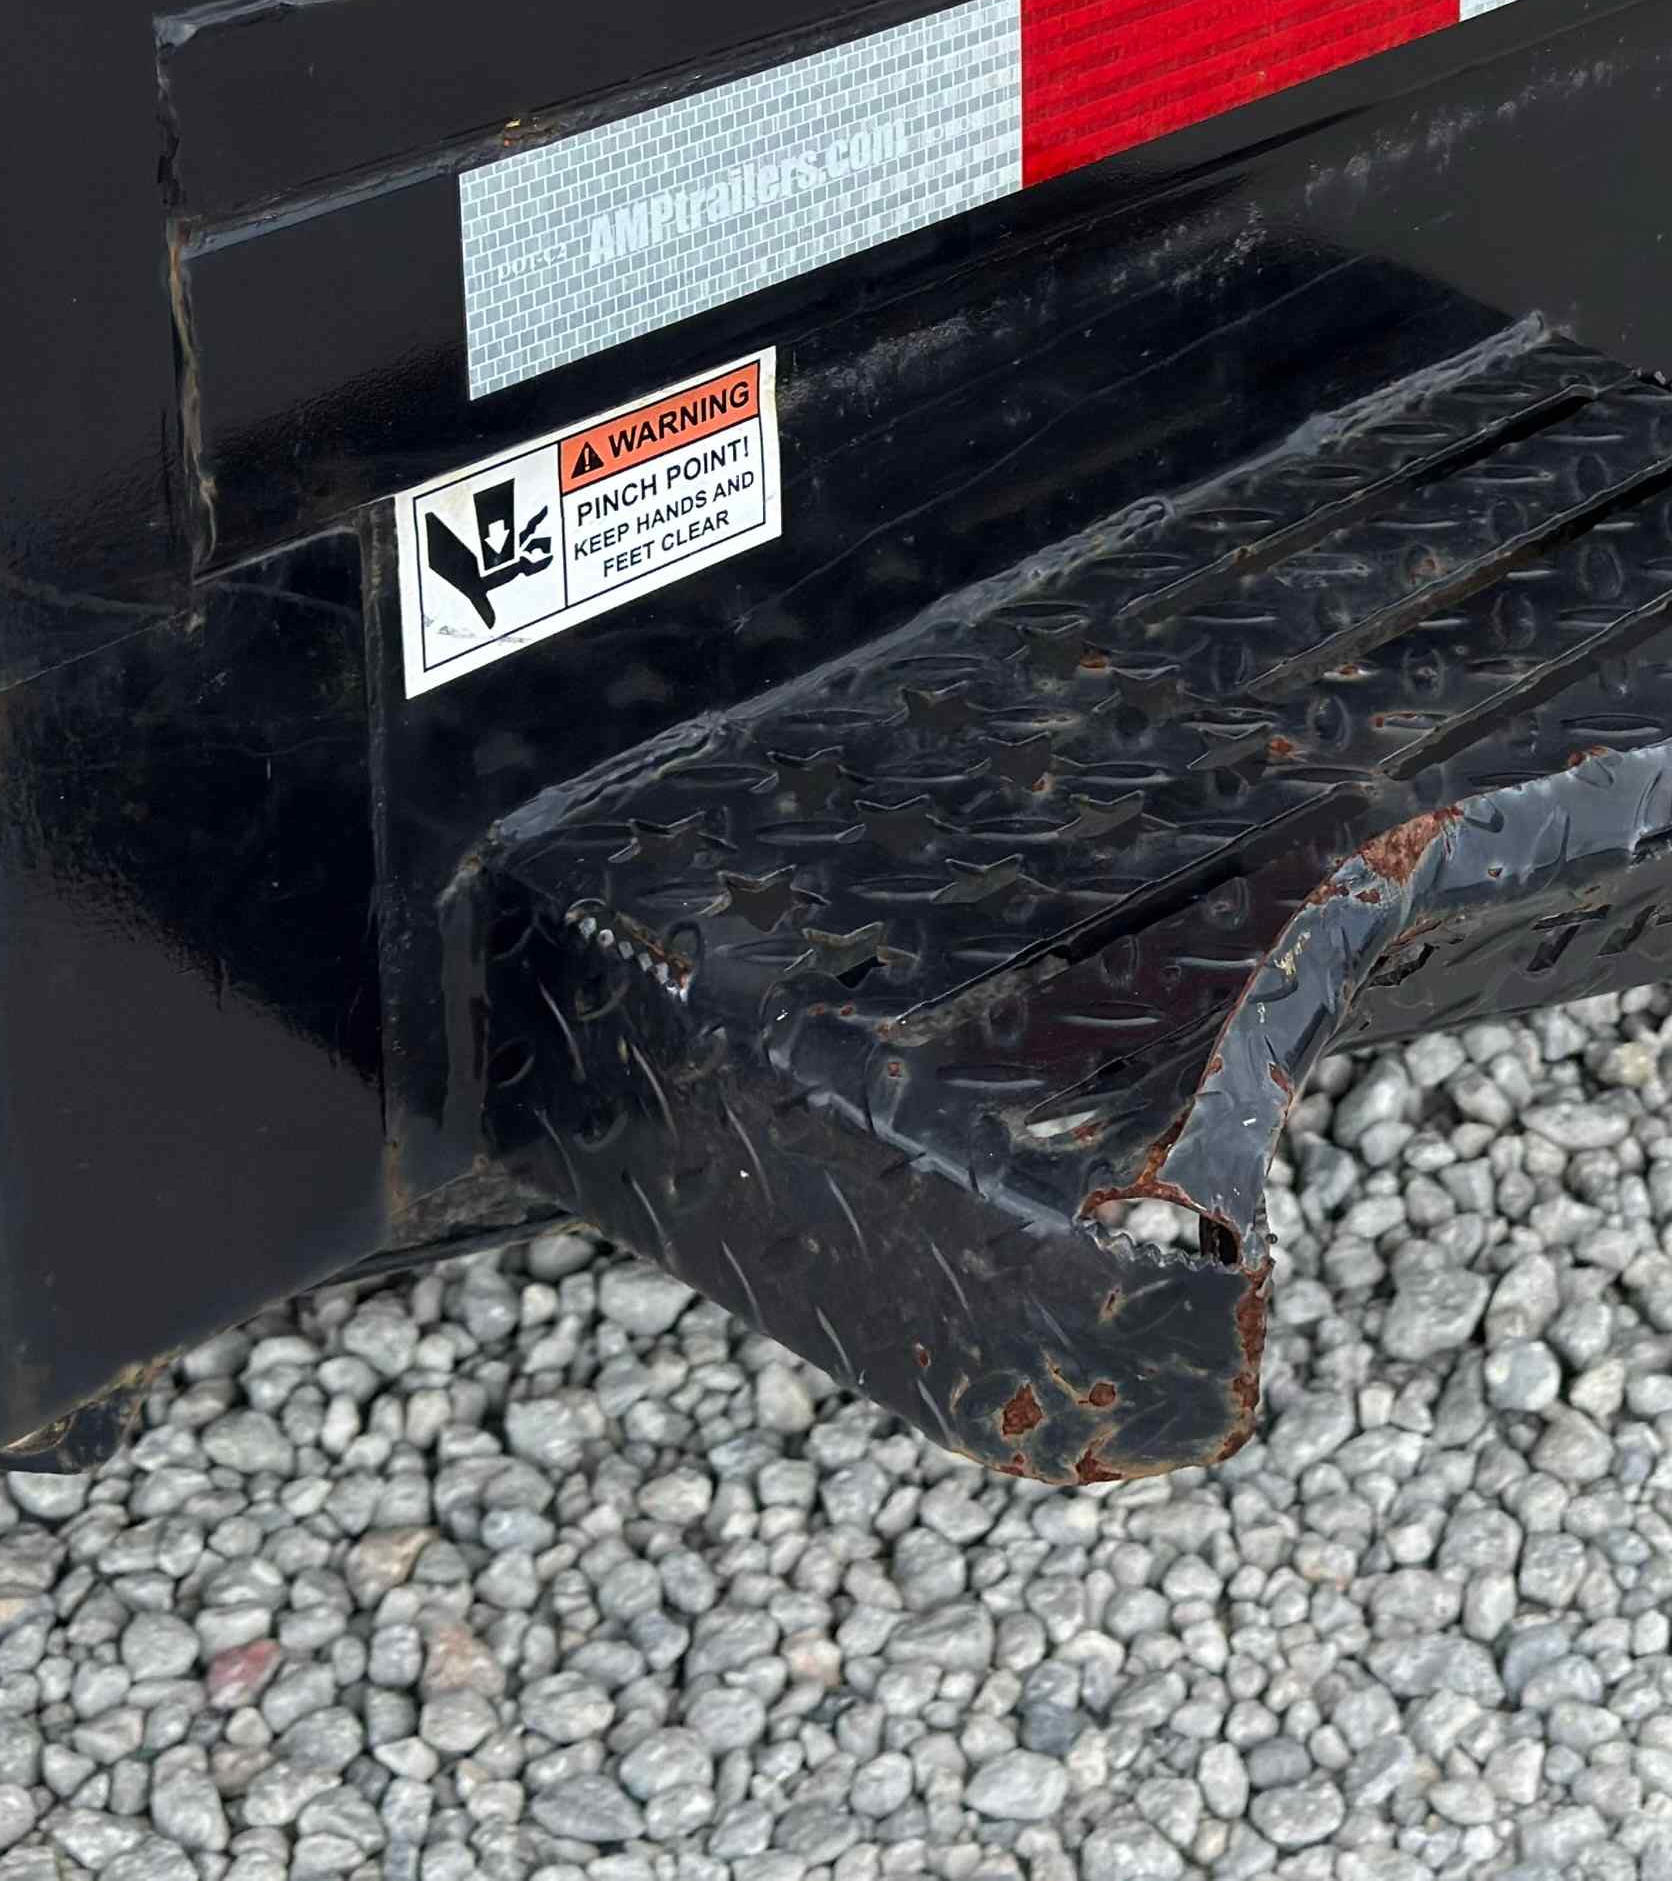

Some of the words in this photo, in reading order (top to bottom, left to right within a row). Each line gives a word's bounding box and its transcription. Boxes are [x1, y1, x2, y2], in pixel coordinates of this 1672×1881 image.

[587, 105, 907, 271] AMPtrailers.com
[608, 381, 748, 457] WARNING
[574, 522, 629, 560] KEEP
[636, 490, 706, 533] HANDS
[712, 470, 753, 501] AND
[577, 474, 656, 526] PINCH
[666, 435, 748, 489] POINT!
[603, 539, 654, 577] FEET
[661, 509, 729, 551] CLEAR
